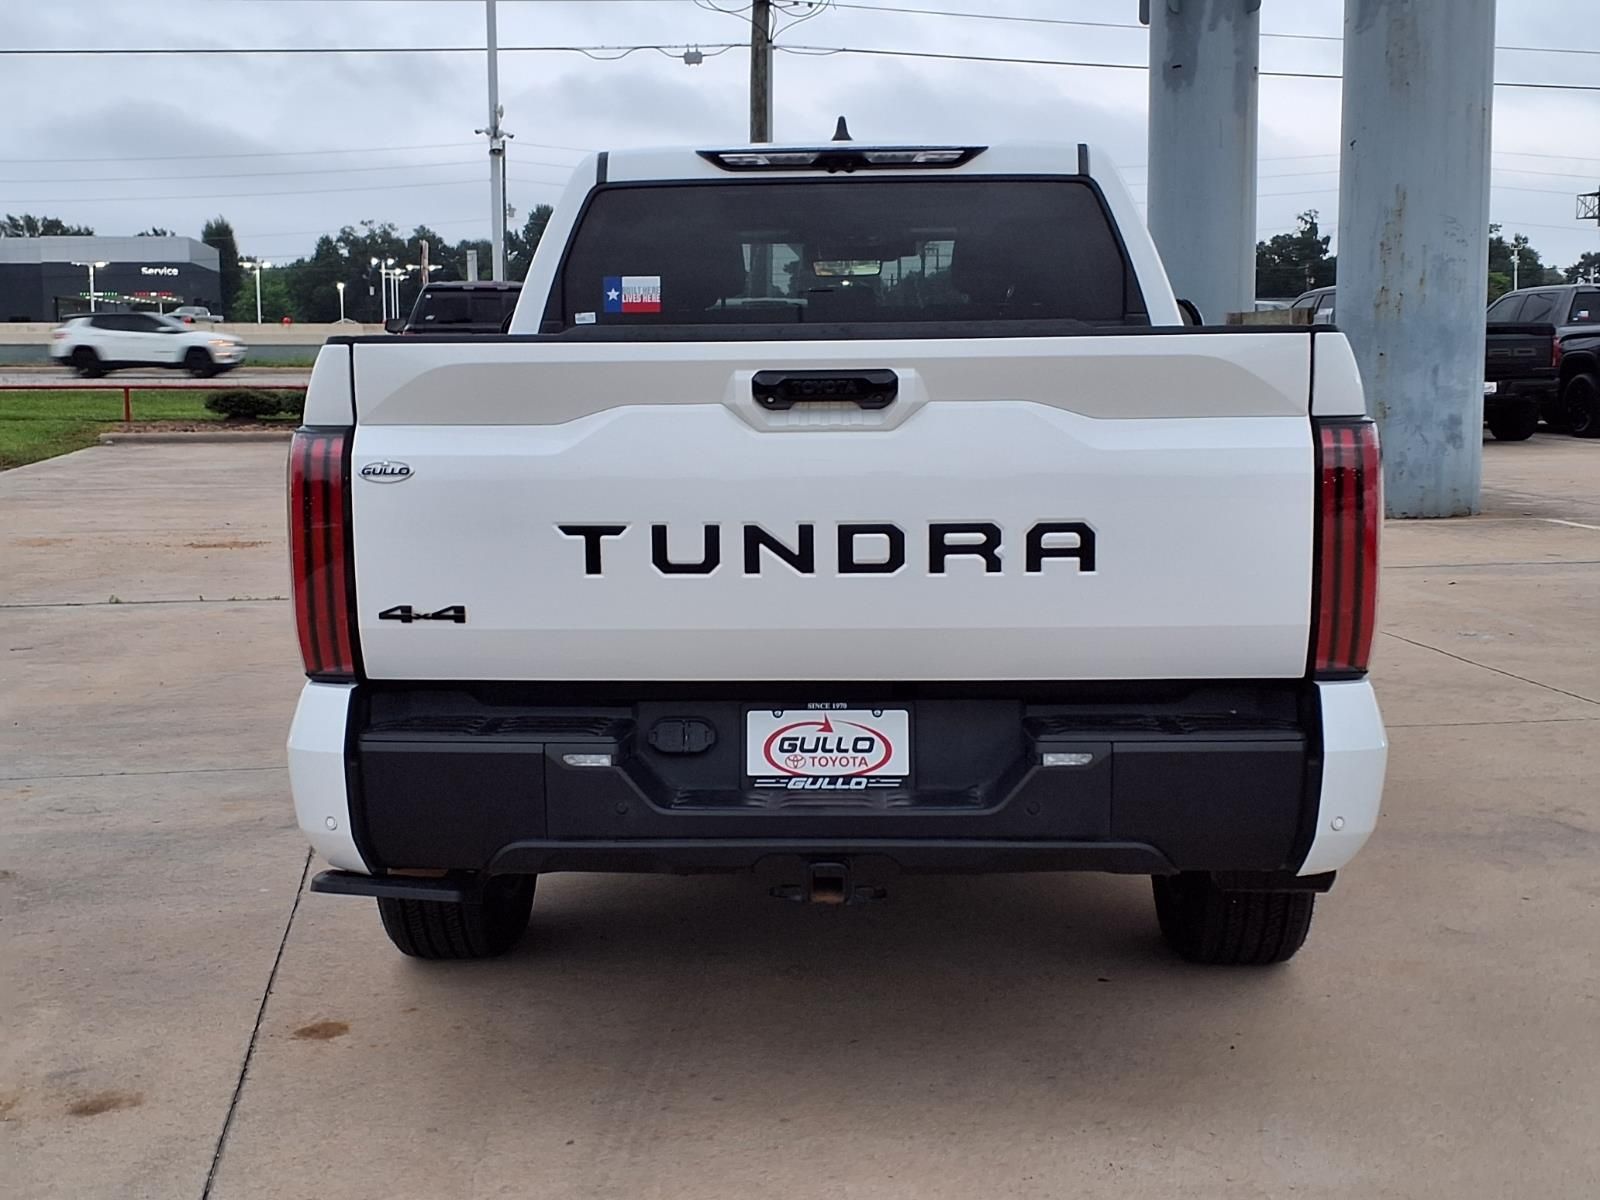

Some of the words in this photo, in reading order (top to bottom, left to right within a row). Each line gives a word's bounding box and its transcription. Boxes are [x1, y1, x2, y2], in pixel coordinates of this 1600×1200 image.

[141, 267, 179, 276] Service
[642, 294, 661, 303] HERE
[791, 380, 858, 394] TOYOTA
[361, 467, 410, 476] GULLO
[556, 522, 1097, 576] TUNDRA
[378, 605, 466, 623] 4x4
[807, 702, 831, 710] SINCE
[832, 702, 848, 710] 1970
[778, 736, 875, 754] GULLO
[809, 756, 869, 768] TOYOTA
[787, 777, 868, 790] GULLO
